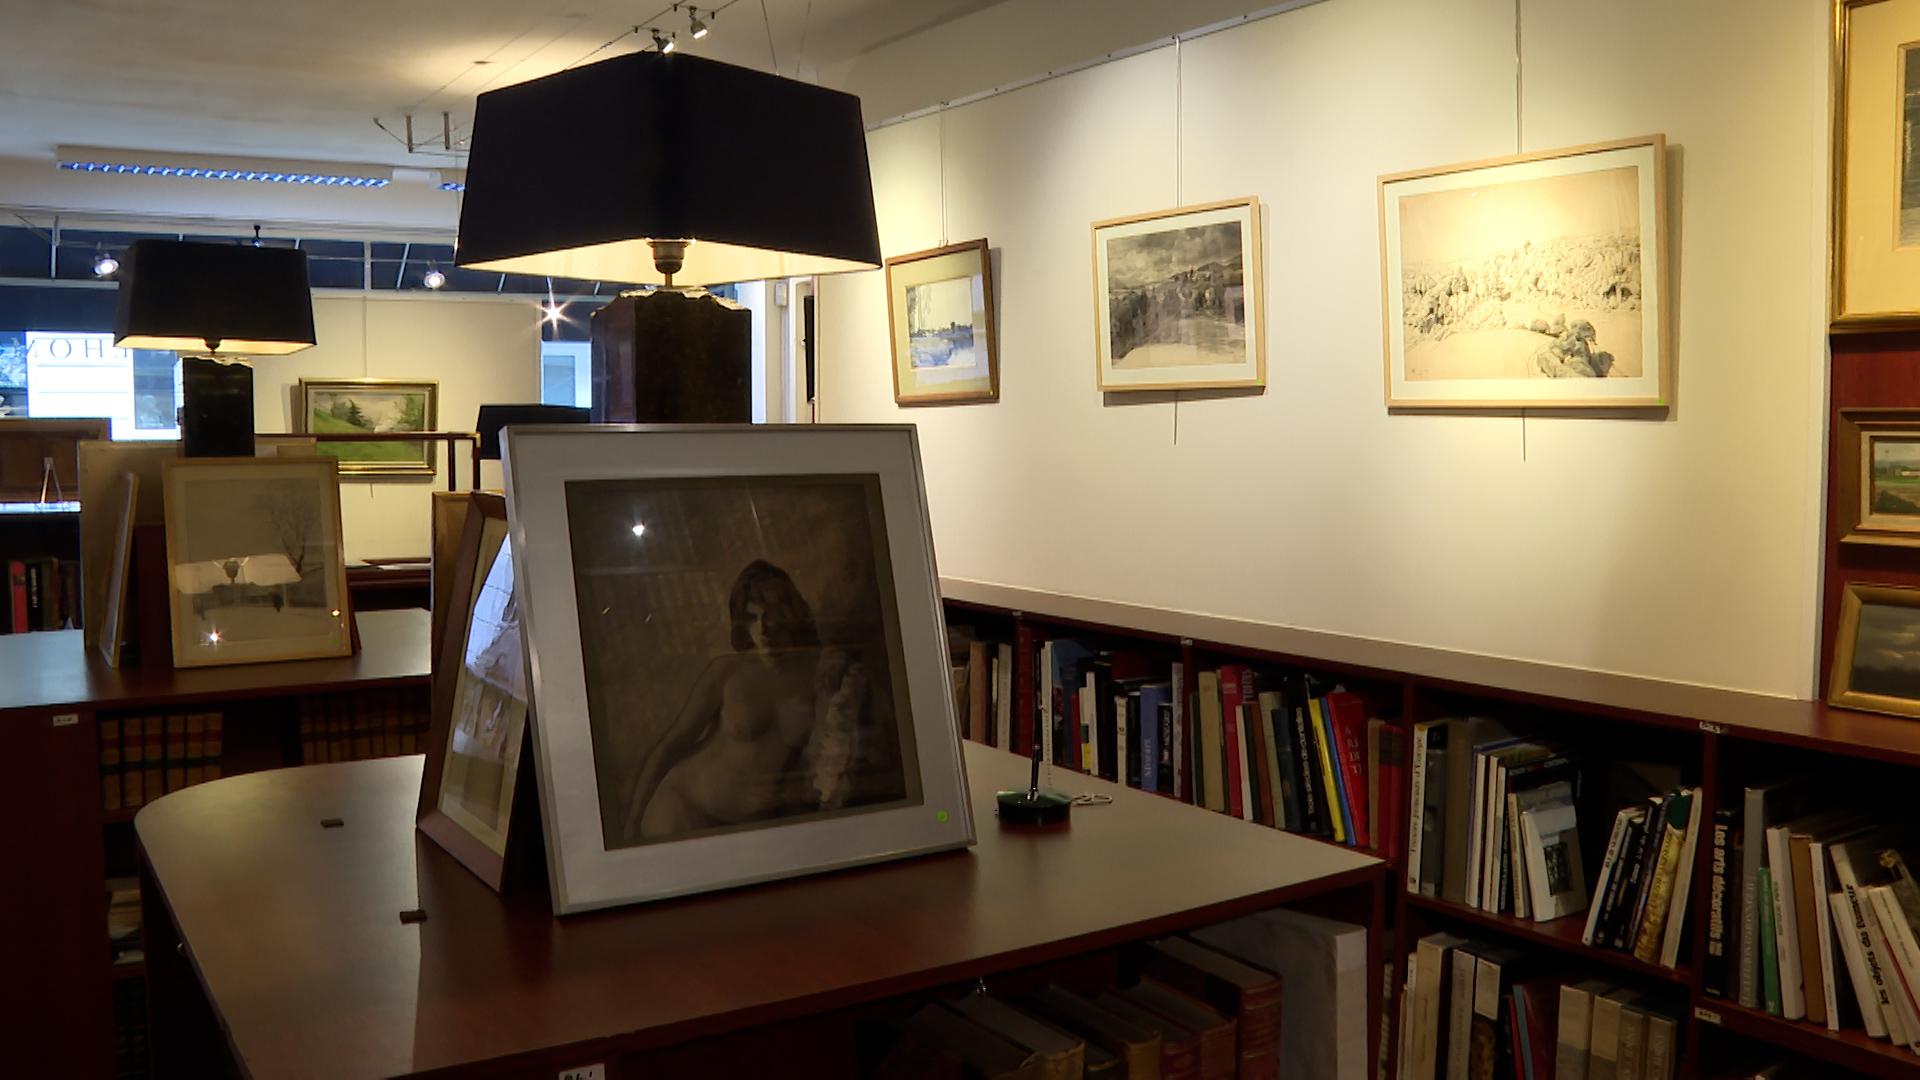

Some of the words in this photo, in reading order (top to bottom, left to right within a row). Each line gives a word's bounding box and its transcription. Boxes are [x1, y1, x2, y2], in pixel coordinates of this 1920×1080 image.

[1714, 824, 1728, 847] Les
[1712, 848, 1726, 874] arts
[1709, 875, 1726, 941] décoratifs
[1866, 950, 1884, 986] objets
